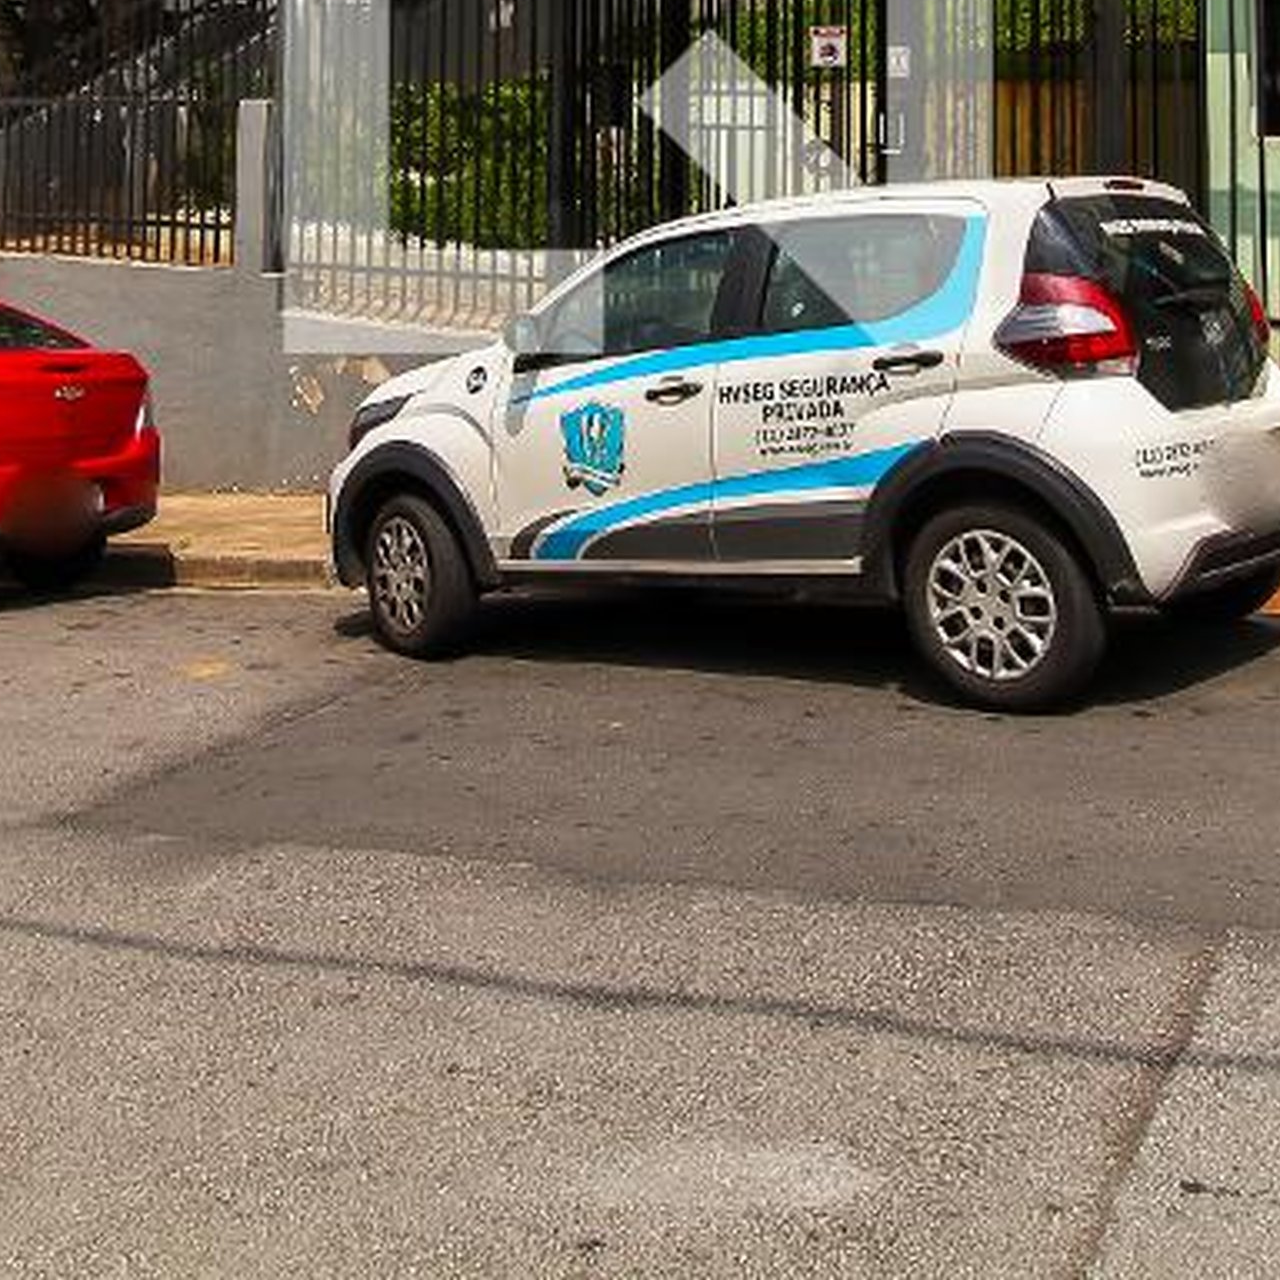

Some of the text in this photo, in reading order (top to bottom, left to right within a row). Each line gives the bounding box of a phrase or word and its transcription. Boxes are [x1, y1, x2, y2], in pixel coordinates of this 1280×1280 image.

[720, 372, 890, 404] HVSEG SEGURANÇA
[762, 400, 844, 423] PRIVADA
